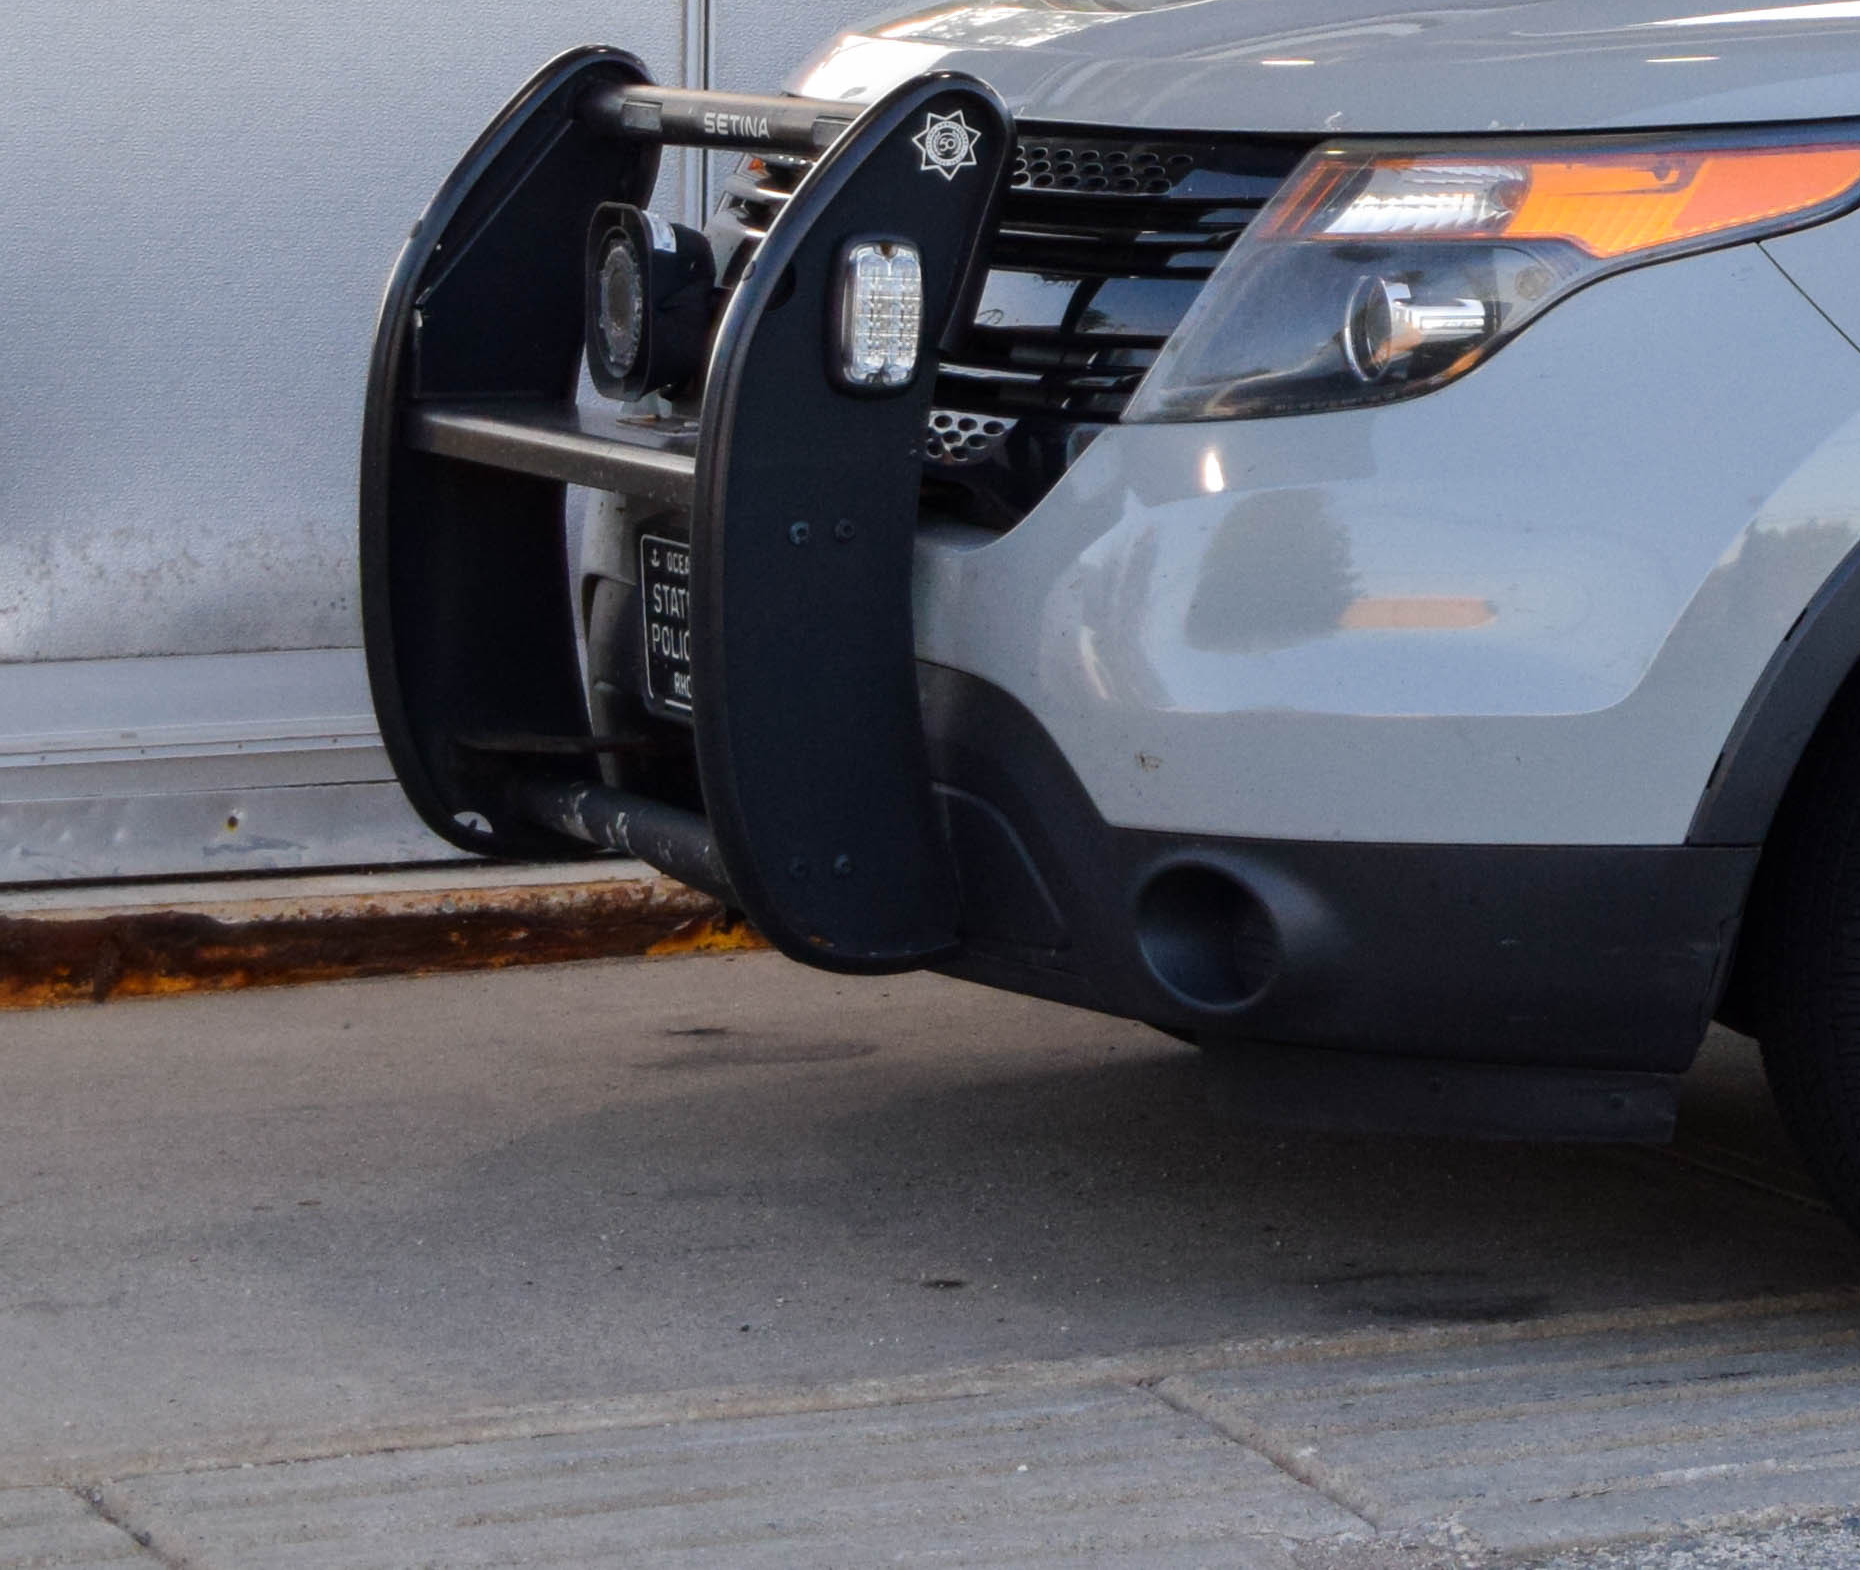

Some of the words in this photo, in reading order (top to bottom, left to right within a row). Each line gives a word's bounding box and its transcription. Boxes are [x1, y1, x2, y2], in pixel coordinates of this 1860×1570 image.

[703, 111, 770, 139] SETINA
[666, 551, 690, 575] OCEA
[652, 582, 690, 619] STAT
[651, 623, 690, 662] POLIC
